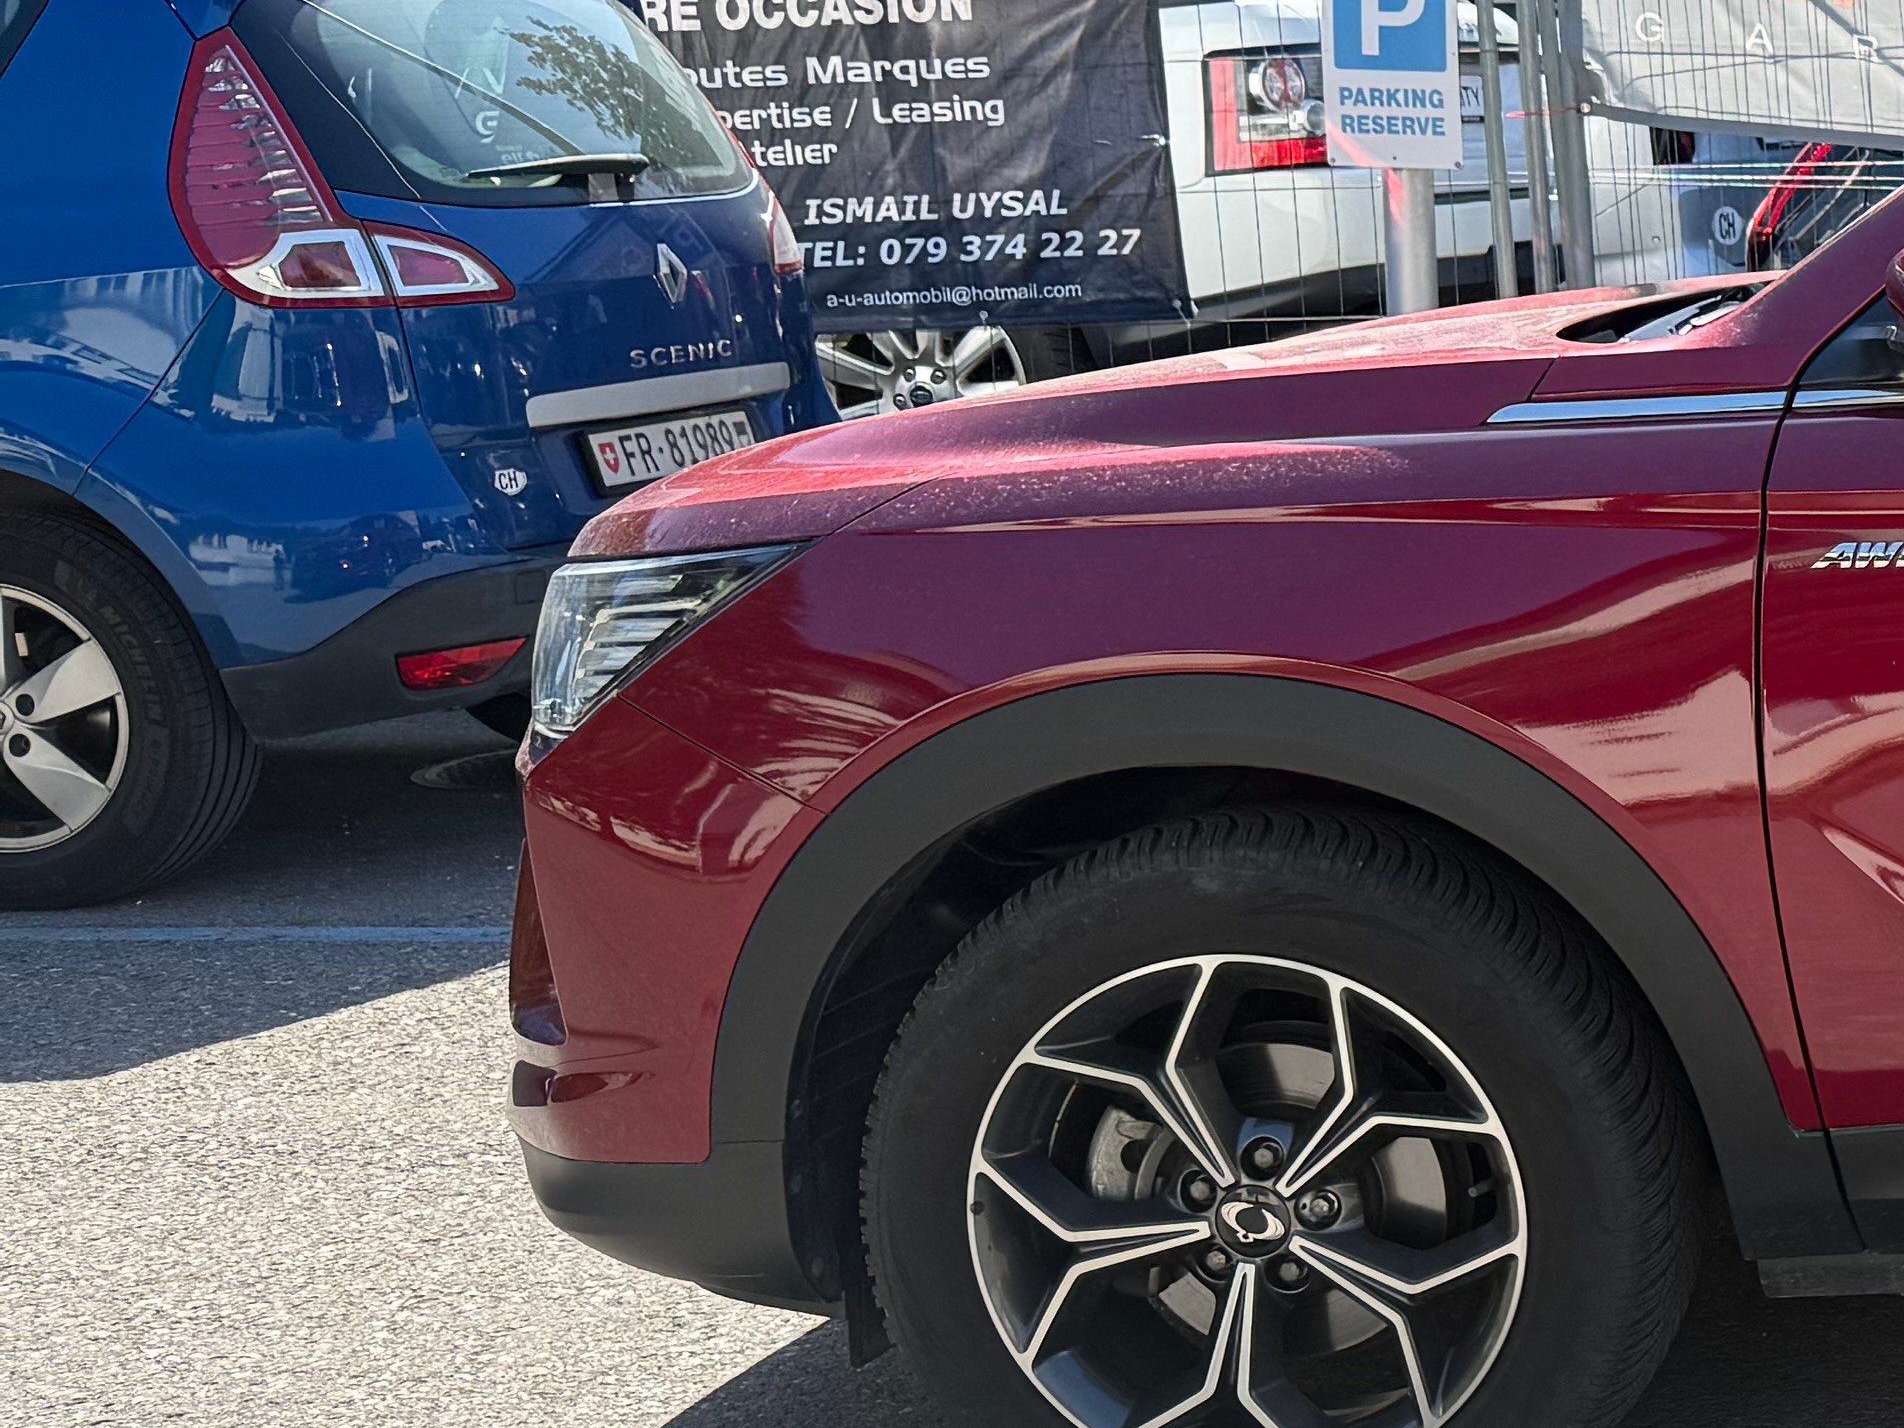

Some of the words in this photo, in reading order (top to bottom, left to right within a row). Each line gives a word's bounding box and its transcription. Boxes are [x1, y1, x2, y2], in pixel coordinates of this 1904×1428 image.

[806, 54, 991, 89] Marques
[872, 96, 1005, 126] Leasing
[1339, 87, 1444, 109] PARKING
[1341, 114, 1446, 137] RESERVE
[803, 194, 939, 226] ISMAIL
[952, 189, 1068, 220] UYSAL
[1719, 212, 1736, 240] CH
[880, 236, 948, 266] 079
[959, 234, 1027, 262] 374
[1040, 230, 1084, 259] 22
[1097, 228, 1141, 256] 27
[826, 282, 1083, 308] a-u-automobil@hotmail.com
[630, 338, 734, 369] SCENIC
[498, 471, 519, 490] CH
